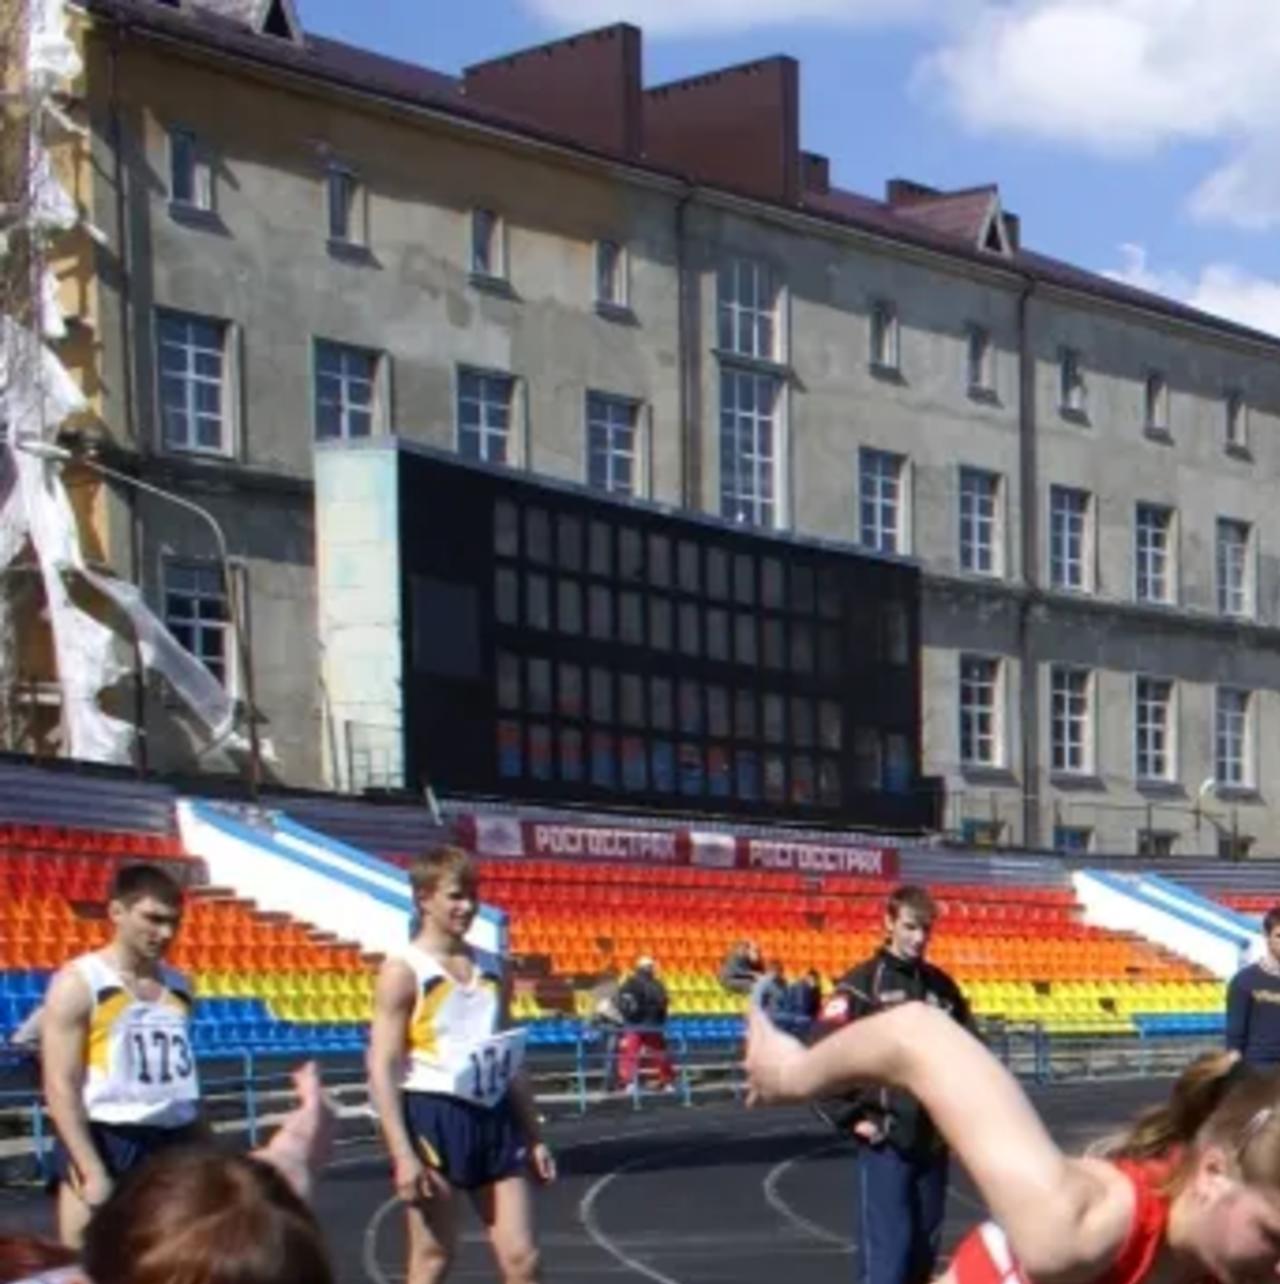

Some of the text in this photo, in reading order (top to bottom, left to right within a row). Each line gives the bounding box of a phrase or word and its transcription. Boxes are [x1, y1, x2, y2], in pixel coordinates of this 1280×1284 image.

[534, 824, 675, 861] РОСГОССТРАХ
[750, 839, 882, 875] РОСГОССТРАХ
[134, 1030, 192, 1084] 173
